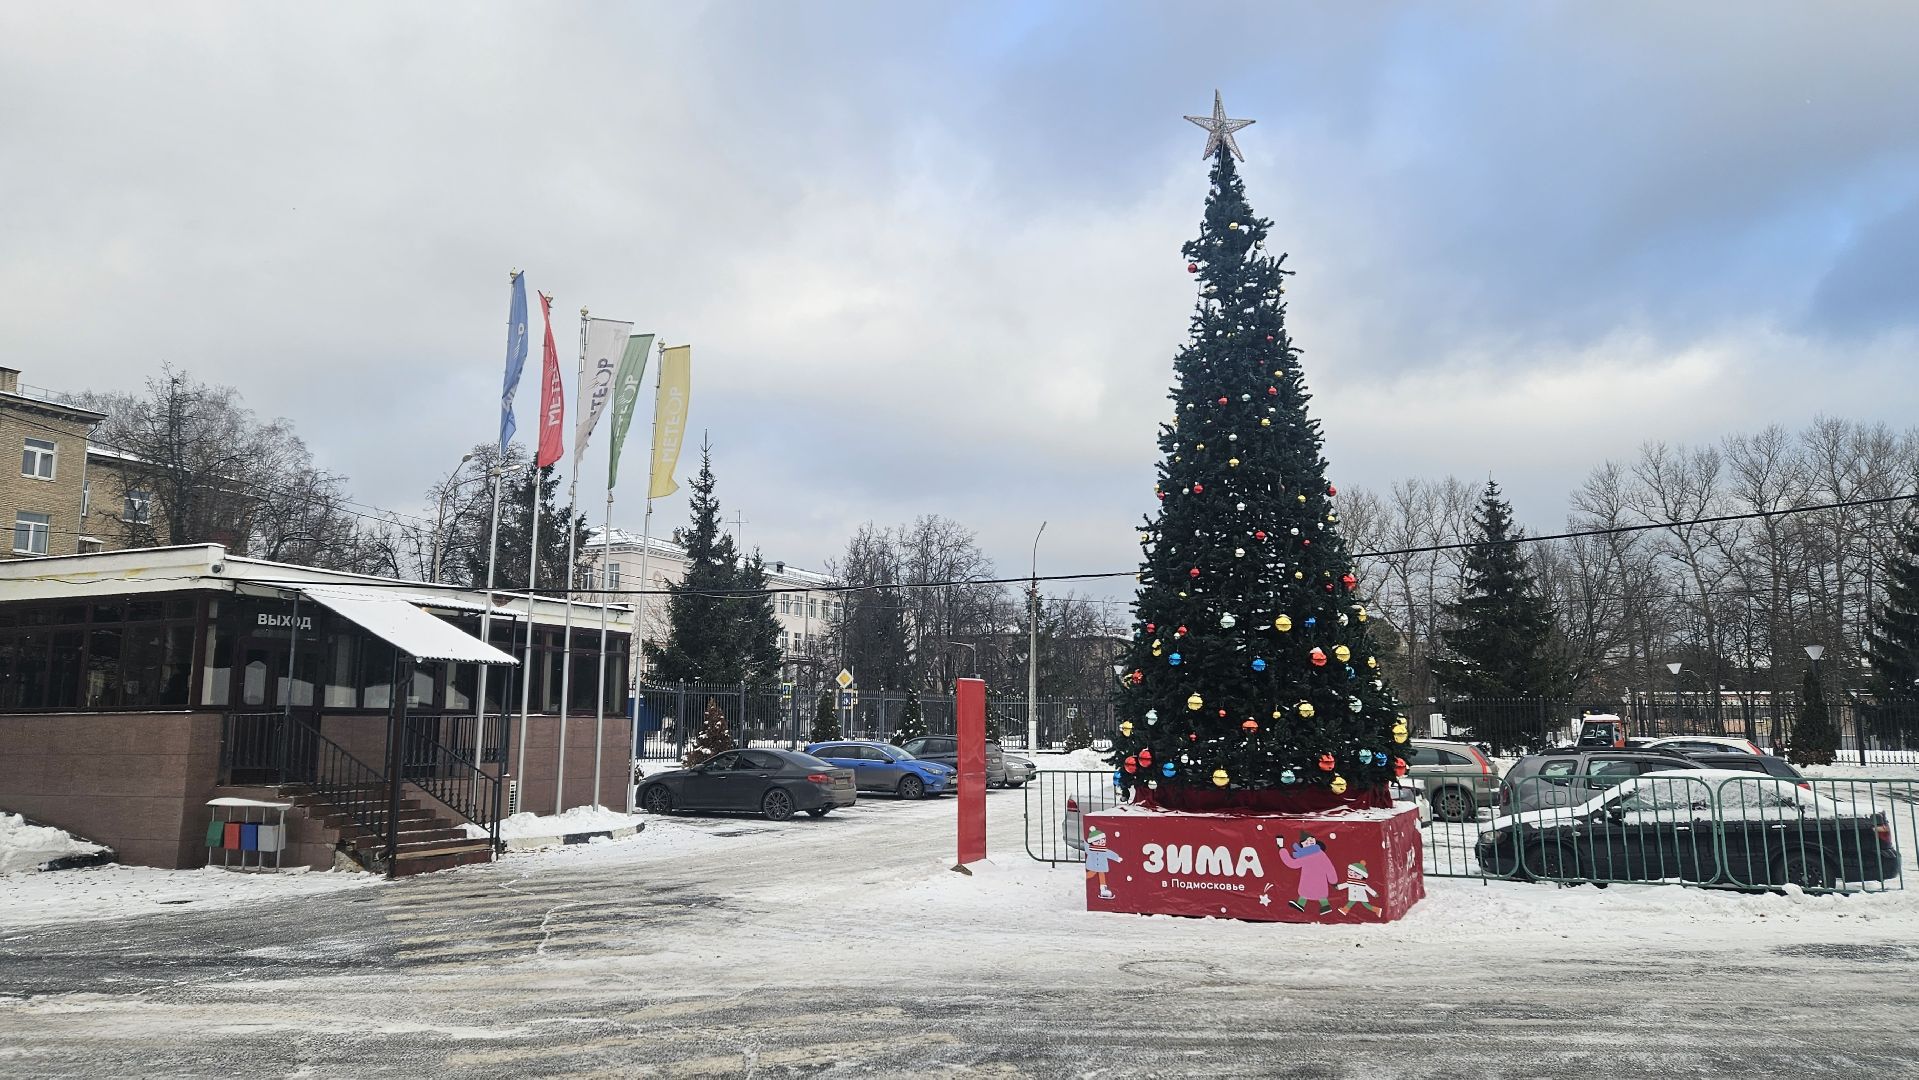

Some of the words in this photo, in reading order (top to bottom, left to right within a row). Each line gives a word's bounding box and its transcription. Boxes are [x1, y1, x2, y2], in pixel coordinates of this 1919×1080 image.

[587, 358, 614, 418] ТЕОР
[661, 386, 683, 463] МЕТЕОР
[258, 613, 311, 629] ВЫХОД
[1142, 843, 1265, 878] ЗИМА
[1171, 878, 1246, 892] Подмосковье
